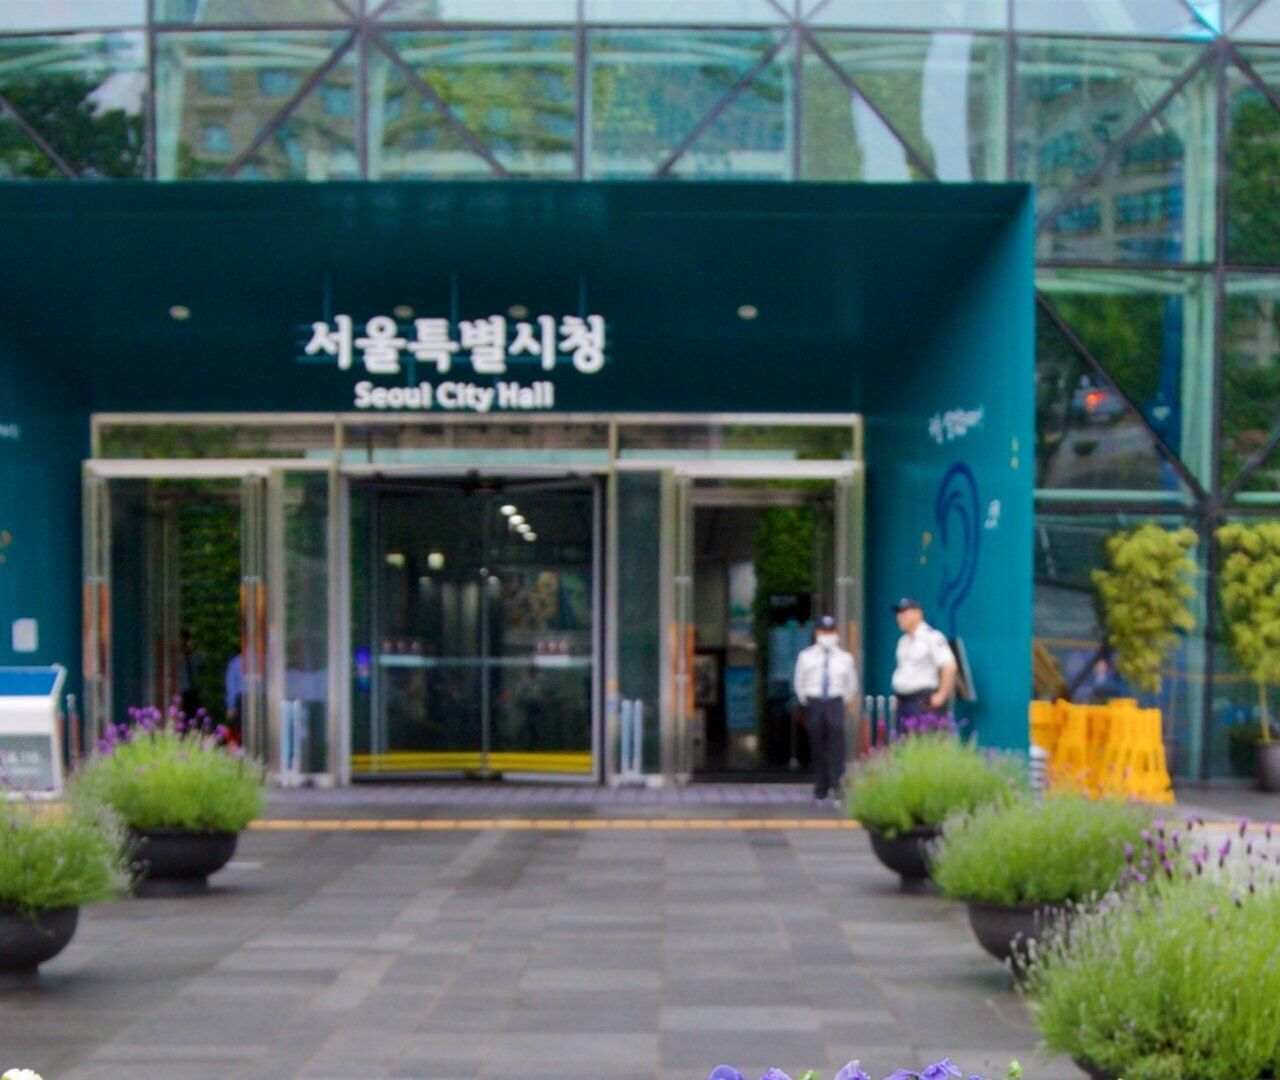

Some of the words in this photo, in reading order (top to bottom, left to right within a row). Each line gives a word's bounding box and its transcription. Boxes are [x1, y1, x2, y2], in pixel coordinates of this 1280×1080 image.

[305, 314, 606, 373] 서울특별시청
[354, 381, 432, 408] Seoul
[436, 381, 495, 412] City
[497, 381, 554, 408] Hall
